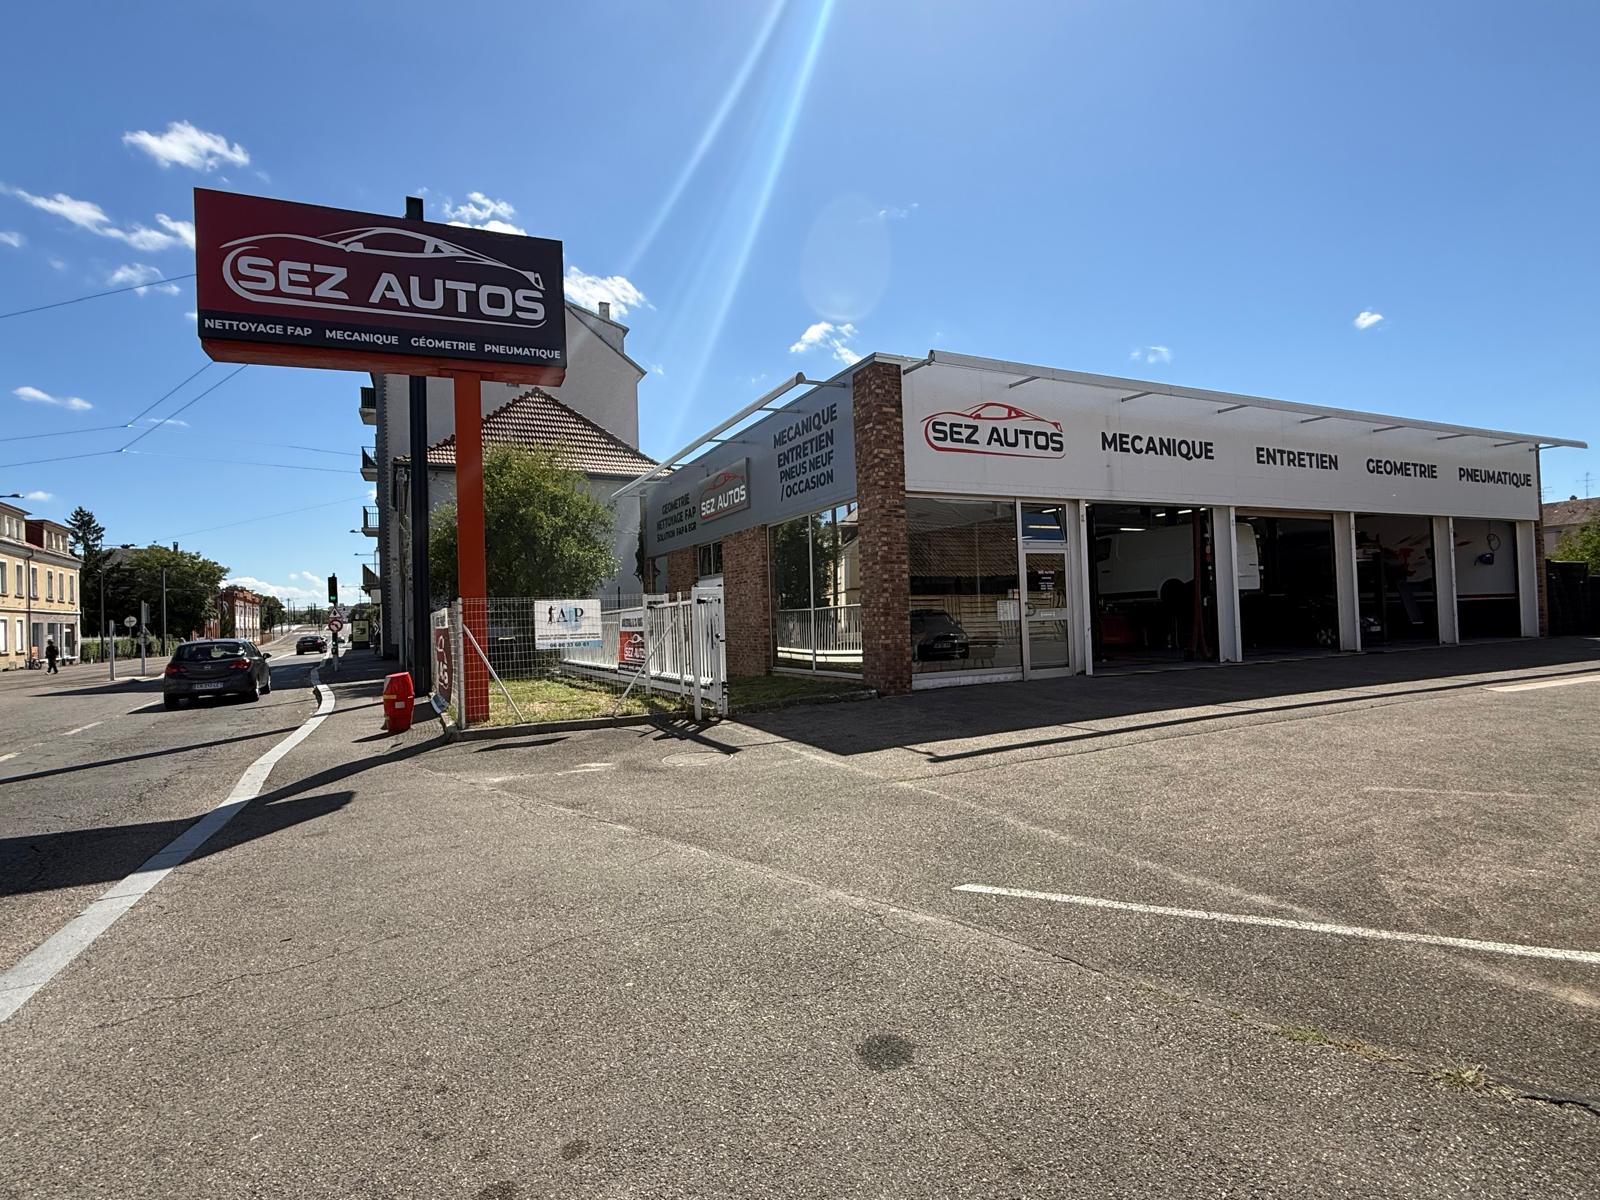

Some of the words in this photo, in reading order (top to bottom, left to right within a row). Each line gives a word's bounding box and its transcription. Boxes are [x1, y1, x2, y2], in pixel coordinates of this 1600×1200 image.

[237, 256, 349, 300] SEZ
[369, 272, 546, 320] AUTOS
[204, 318, 284, 335] NETTOYAGE
[287, 325, 313, 337] FAP
[325, 329, 399, 345] MECANIQUE
[411, 336, 476, 352] GÉOMETRIE
[484, 343, 561, 359] PNEUMATIQUE
[773, 402, 838, 449] MECANIQUE
[931, 421, 980, 445] SEZ
[986, 426, 1064, 452] AUTOS
[777, 429, 834, 468] ENTRETIEN
[1101, 431, 1215, 461] MECANIQUE
[1255, 446, 1339, 471] ENTRETIEN
[780, 461, 807, 484] PNEUS
[808, 449, 834, 473] NEUF
[1366, 458, 1438, 480] GEOMETRIE
[1458, 467, 1532, 488] PNEUMATIQUE
[684, 505, 697, 521] FAP
[701, 498, 716, 516] SEZ
[717, 484, 746, 511] AUTOS
